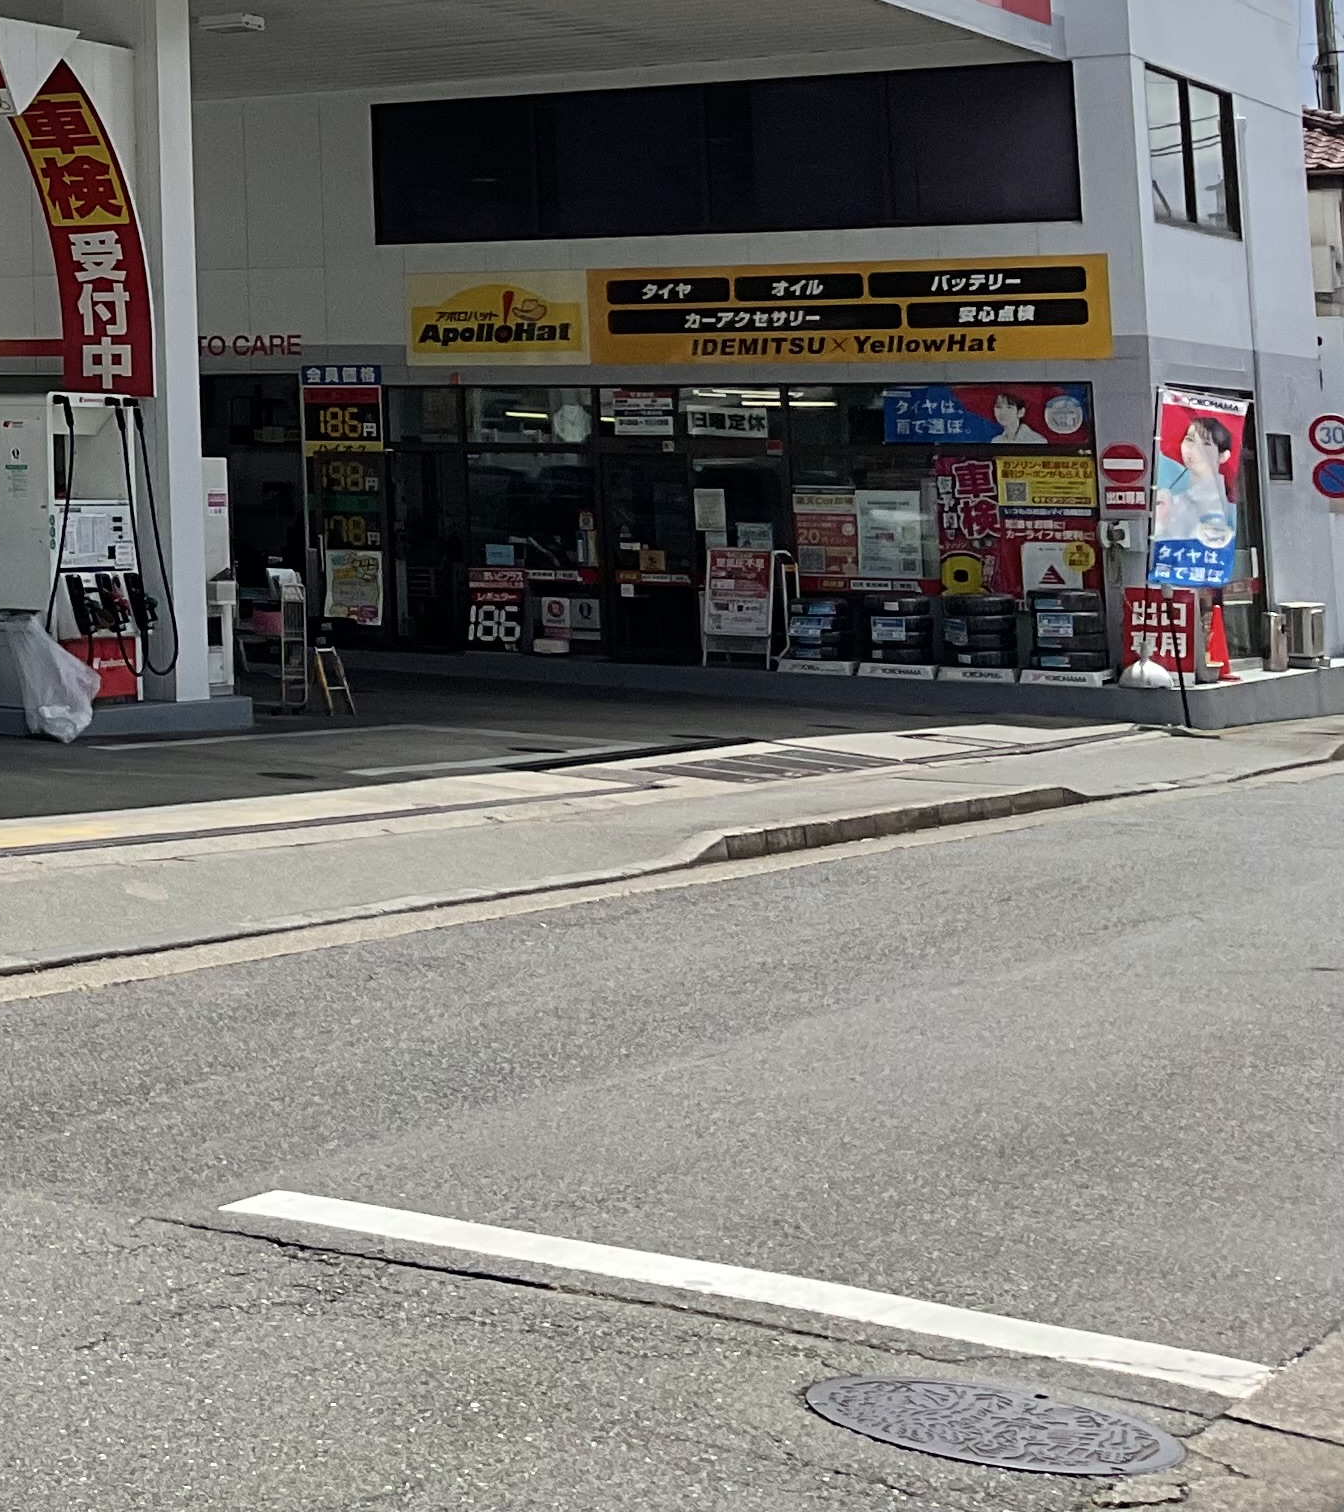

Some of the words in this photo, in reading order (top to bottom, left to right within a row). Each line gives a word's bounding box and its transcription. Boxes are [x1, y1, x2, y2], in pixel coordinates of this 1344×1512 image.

[641, 283, 692, 300] タイヤ
[771, 280, 824, 297] オイル
[930, 273, 1021, 292] バッテリー
[684, 312, 821, 330] カーアクセサリー
[958, 305, 1037, 323] 安心点検
[232, 334, 303, 357] CARE
[691, 411, 767, 432] 日曜定休
[1318, 425, 1344, 445] 30
[1158, 544, 1226, 567] タイヤは、
[467, 604, 521, 642] 186
